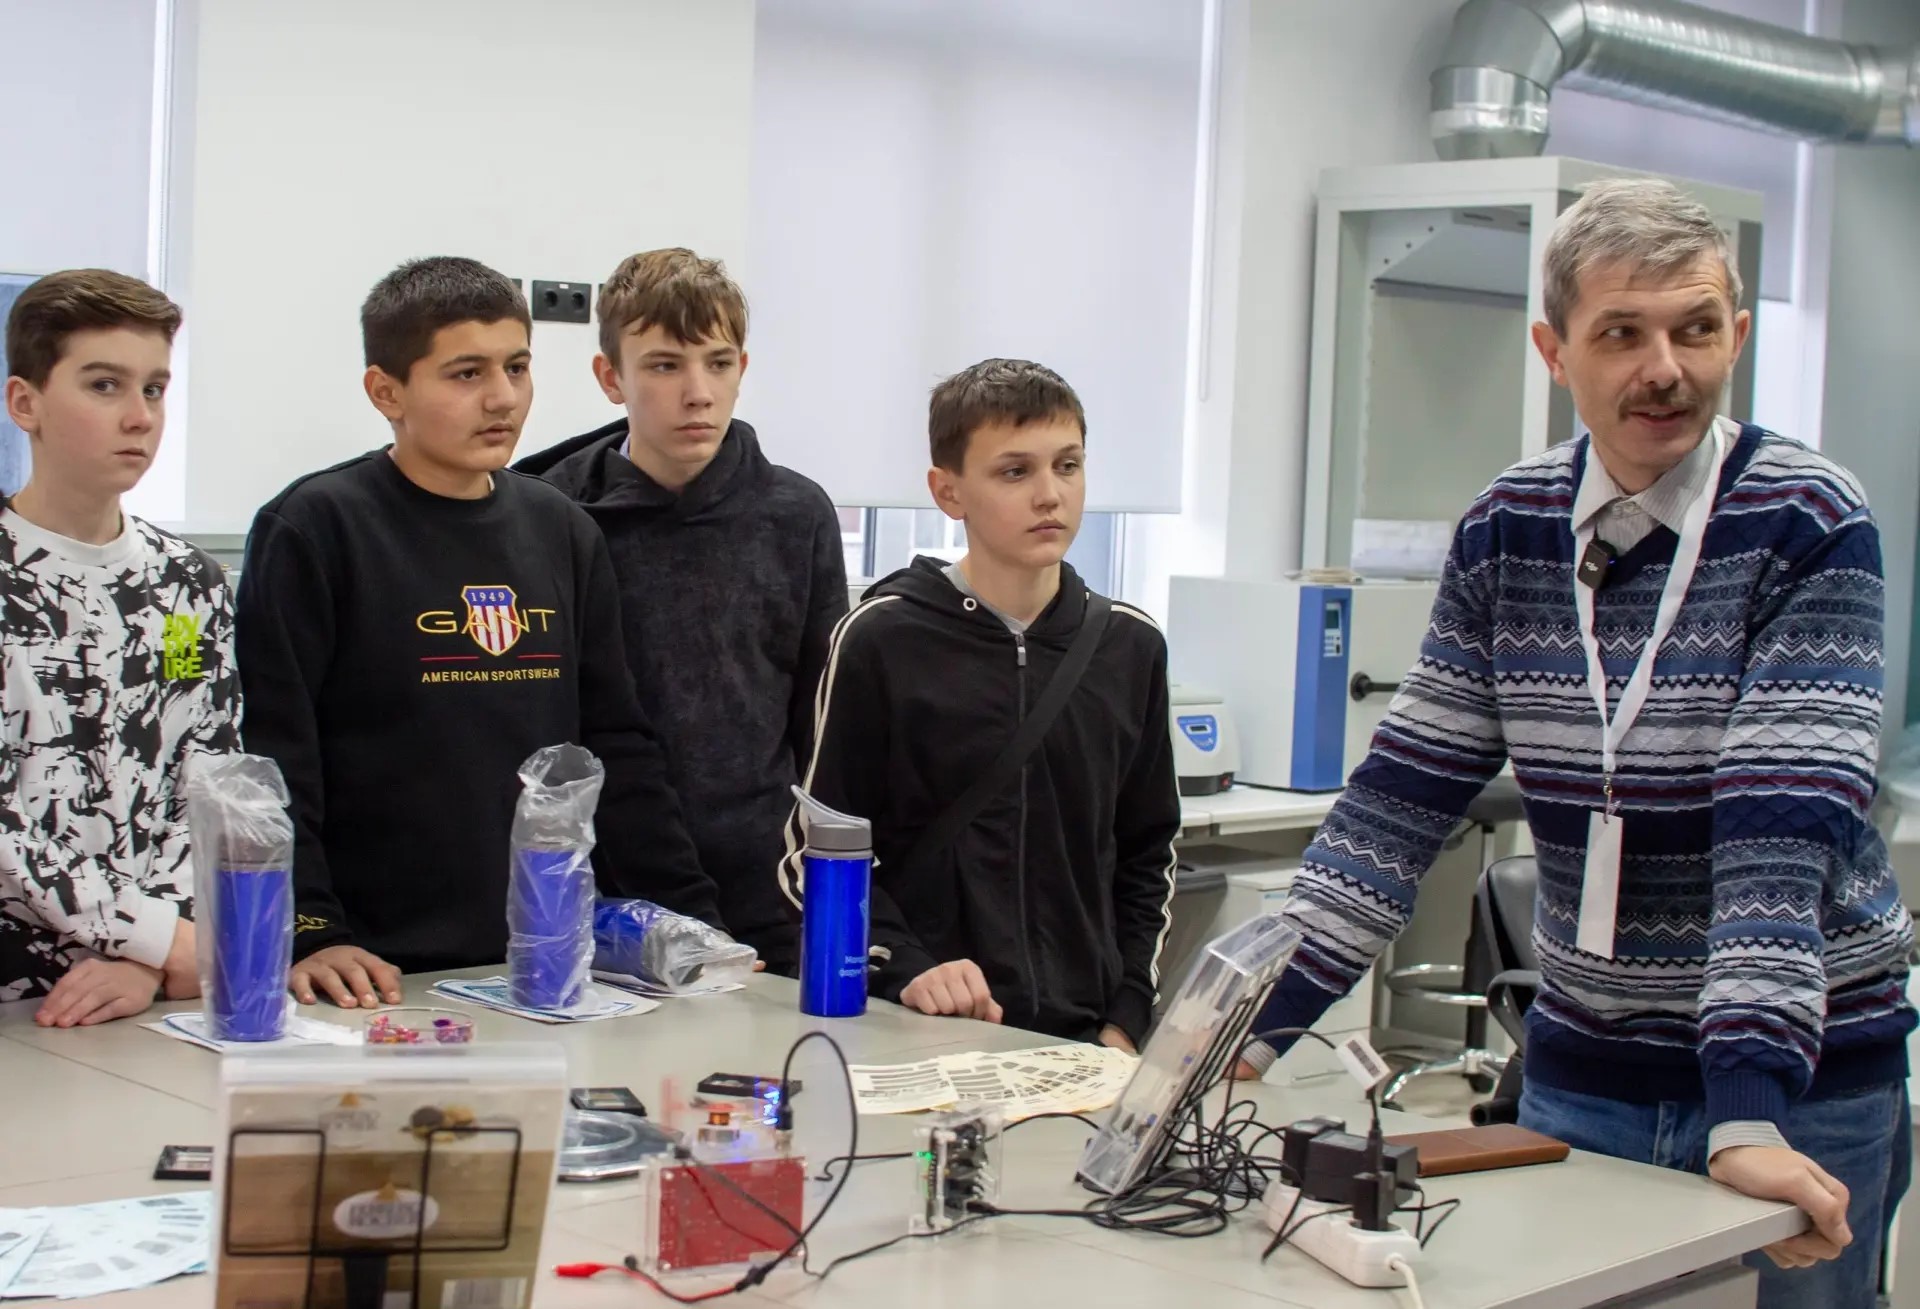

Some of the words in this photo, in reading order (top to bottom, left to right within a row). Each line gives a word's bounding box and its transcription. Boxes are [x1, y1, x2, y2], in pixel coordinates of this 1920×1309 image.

[471, 592, 505, 601] 1949
[416, 609, 556, 634] GANT
[422, 671, 489, 683] AMERICAN
[492, 668, 560, 681] SPORTSWEAR
